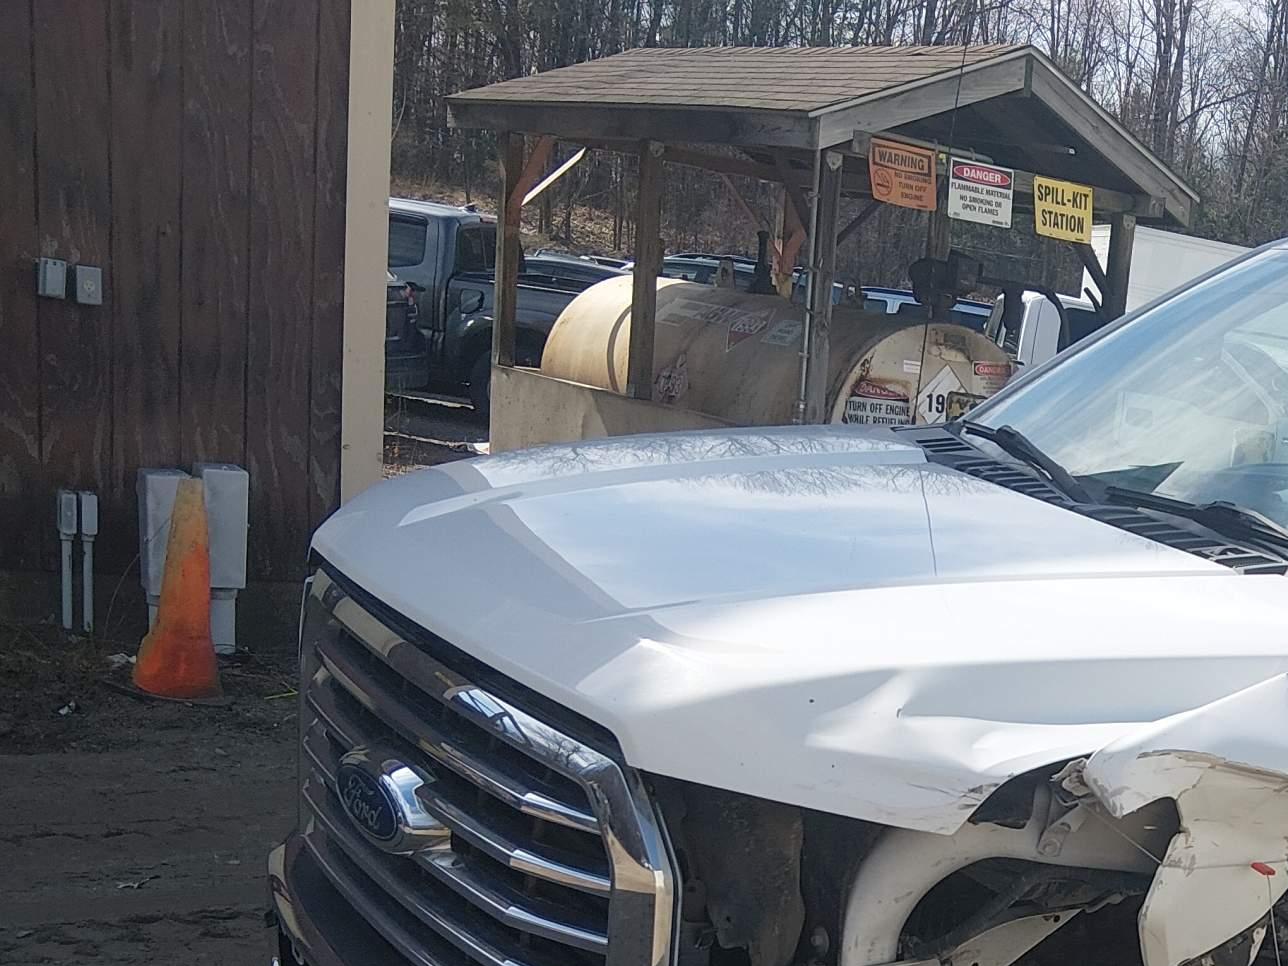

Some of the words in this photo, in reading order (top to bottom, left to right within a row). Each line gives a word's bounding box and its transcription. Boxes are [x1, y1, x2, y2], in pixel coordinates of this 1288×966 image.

[878, 150, 925, 171] WARNING
[963, 167, 1002, 183] DANGER
[899, 182, 914, 191] TURN
[915, 184, 928, 192] OFF
[951, 182, 985, 195] FLAMMABLE
[985, 189, 1011, 200] MATERIAL
[969, 196, 994, 207] SMOKING
[1037, 183, 1089, 211] SPILL-KIT
[962, 203, 977, 212] OPEN
[978, 206, 999, 216] FLAMES
[1041, 208, 1084, 234] STATION
[849, 400, 867, 412] TURN
[870, 402, 883, 414] OFF
[885, 404, 910, 417] ENGINE
[926, 393, 945, 413] 19
